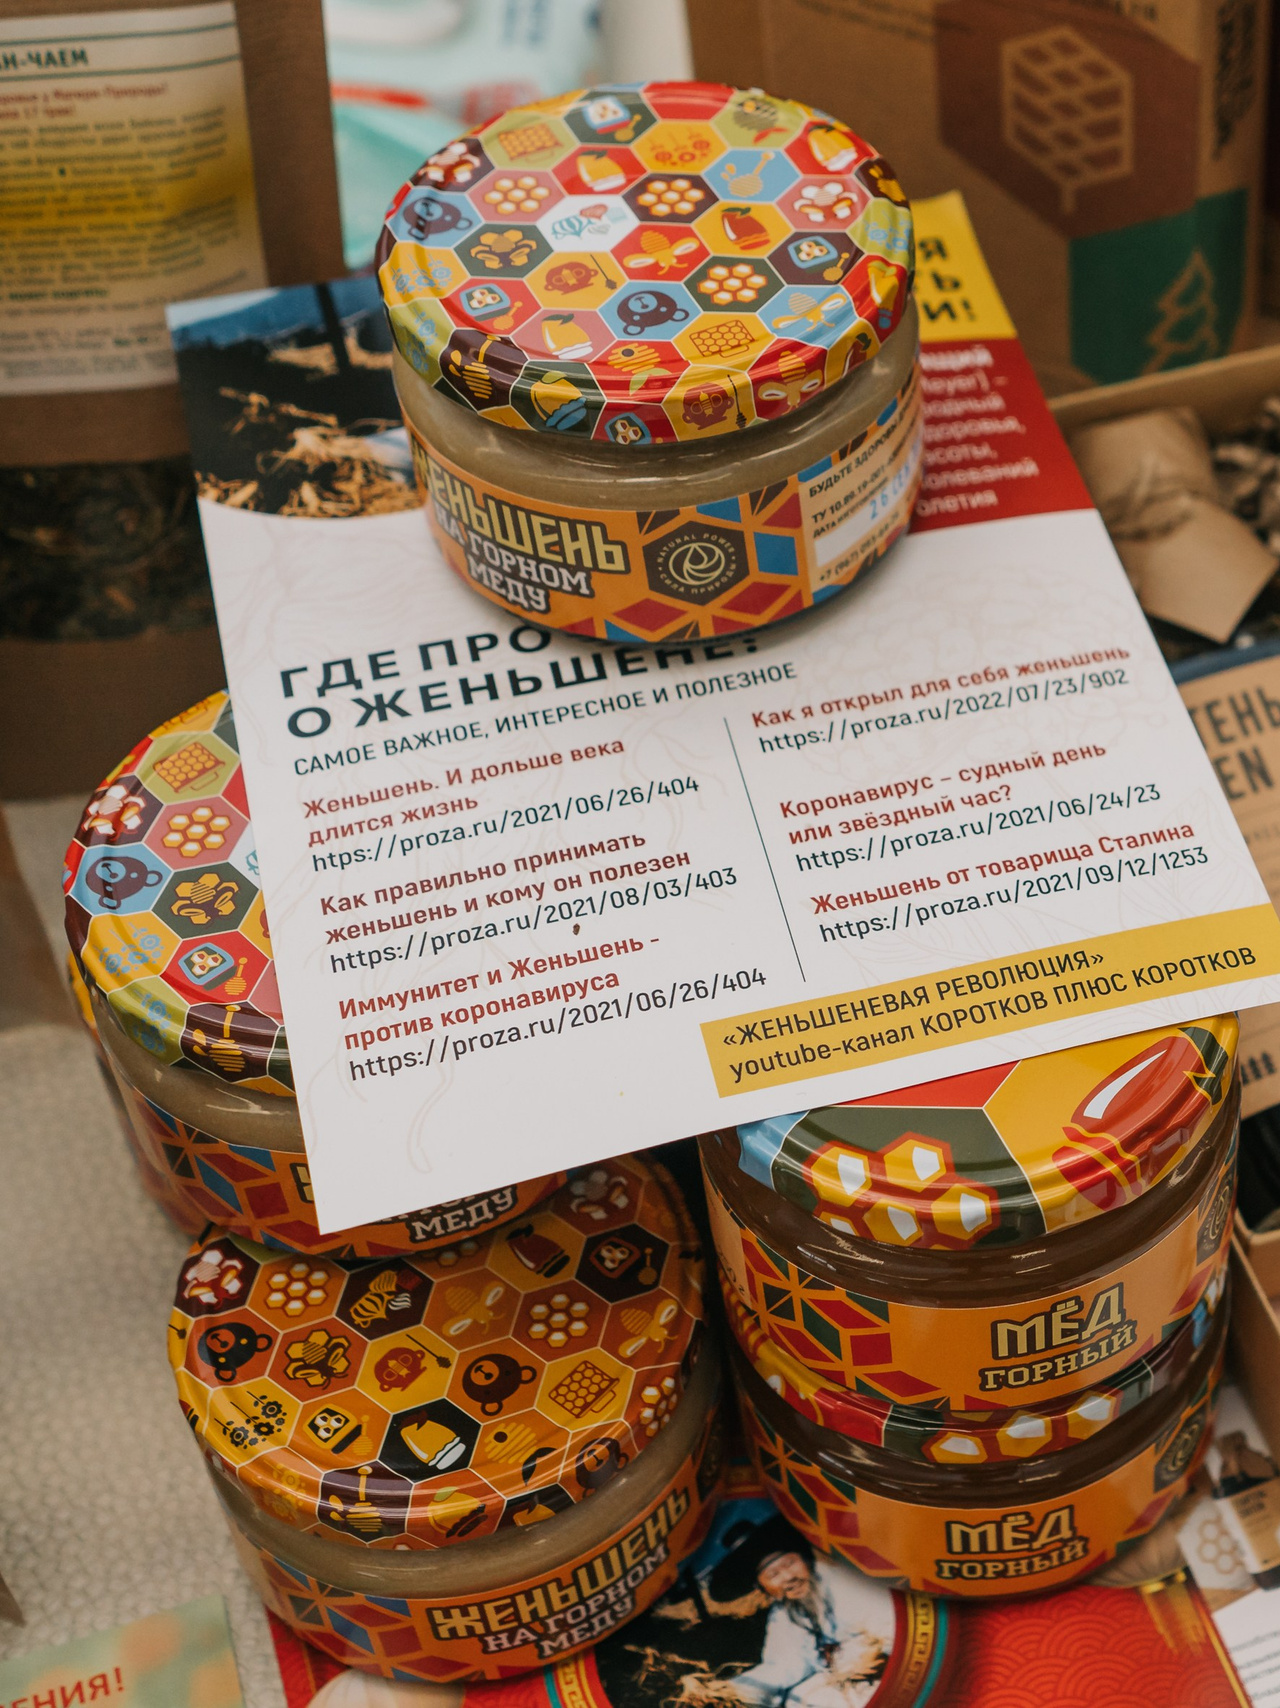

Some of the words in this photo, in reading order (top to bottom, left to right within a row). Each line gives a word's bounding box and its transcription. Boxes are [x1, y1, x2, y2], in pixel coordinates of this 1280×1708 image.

[0, 49, 89, 71] Н-ЧАЕМ
[809, 462, 852, 498] БУДЬТЕ
[811, 508, 828, 525] ТУ
[467, 530, 591, 596] ГОРНОМ
[468, 556, 548, 612] МЕДУ
[656, 532, 697, 563] NATURAL
[702, 531, 736, 553] POWER
[659, 573, 685, 593] СИЛА
[279, 648, 401, 699] ГДЕ
[417, 624, 552, 671] ПРО
[752, 705, 797, 729] Как
[801, 701, 815, 719] я
[820, 687, 903, 725] открыл
[911, 676, 952, 700] для
[957, 664, 1010, 689] себя
[1015, 645, 1131, 679] женьшень
[287, 705, 332, 740] О
[293, 743, 376, 777] САМОЕ
[384, 722, 491, 758] ВАЖНОЕ,
[496, 692, 647, 734] ИНТЕРЕСНОЕ
[652, 686, 669, 705] И
[676, 662, 797, 700] ПОЛЕЗНОЕ
[758, 667, 1130, 756] https://proza.ru/2022/07/23/902
[302, 776, 441, 821] Женьшень.
[446, 768, 464, 788] И
[470, 751, 564, 786] дольше
[570, 738, 626, 765] века
[779, 773, 935, 820] Коронавирус
[957, 750, 1047, 786] судный
[1053, 741, 1107, 768] день
[788, 822, 833, 846] или
[838, 795, 956, 837] звёздный
[960, 783, 1013, 810] час?
[307, 813, 396, 850] длится
[401, 795, 480, 830] жизнь
[312, 775, 701, 874] htps://proza.ru/2021/06/26/404
[795, 783, 1162, 873] https://proza.ru/2021/06/24/23
[319, 892, 368, 917] Как
[373, 859, 507, 905] правильно
[514, 830, 647, 876] принимать
[324, 902, 459, 946] женьшень
[464, 894, 481, 915] и
[486, 878, 547, 914] кому
[552, 871, 582, 894] он
[588, 850, 692, 887] полезен
[811, 875, 942, 916] Женьшень
[946, 865, 972, 886] от
[976, 840, 1094, 882] товарища
[1098, 821, 1196, 855] Сталина
[819, 845, 1210, 945] https://proza.ru/2021/09/12/1253
[329, 865, 739, 975] https://proza.ru/2021/08/03/403
[338, 972, 481, 1021] Иммунитет
[487, 967, 504, 987] и
[508, 936, 645, 983] Женьшень
[344, 1014, 434, 1053] против
[440, 969, 621, 1030] коронавируса
[722, 986, 931, 1048] «ЖЕНЬШЕНЕВАЯ
[935, 948, 1105, 1005] РЕВОЛЮЦИЯ»
[728, 1024, 916, 1083] youtube-канал
[921, 990, 1050, 1037] КОРОТКОВ
[1055, 972, 1129, 1007] ПЛЮС
[1132, 944, 1259, 989] КОРОТКОВ
[349, 967, 768, 1082] https://proza.ru/2021/06/26/404
[412, 1186, 515, 1242] МЕДУ
[983, 1323, 1136, 1391] ГОРНЫЙ
[996, 1286, 1126, 1358] МЁД
[431, 1491, 691, 1641] ЖЕНЬШЕНЬ
[937, 1536, 1088, 1581] ГОРНЫЙ
[948, 1507, 1076, 1554] МЁД
[483, 1623, 539, 1653] НА
[547, 1544, 671, 1636] ГОРНОМ
[538, 1597, 637, 1659] МЕДУ
[0, 1666, 126, 1708] ЕНИЯ!
